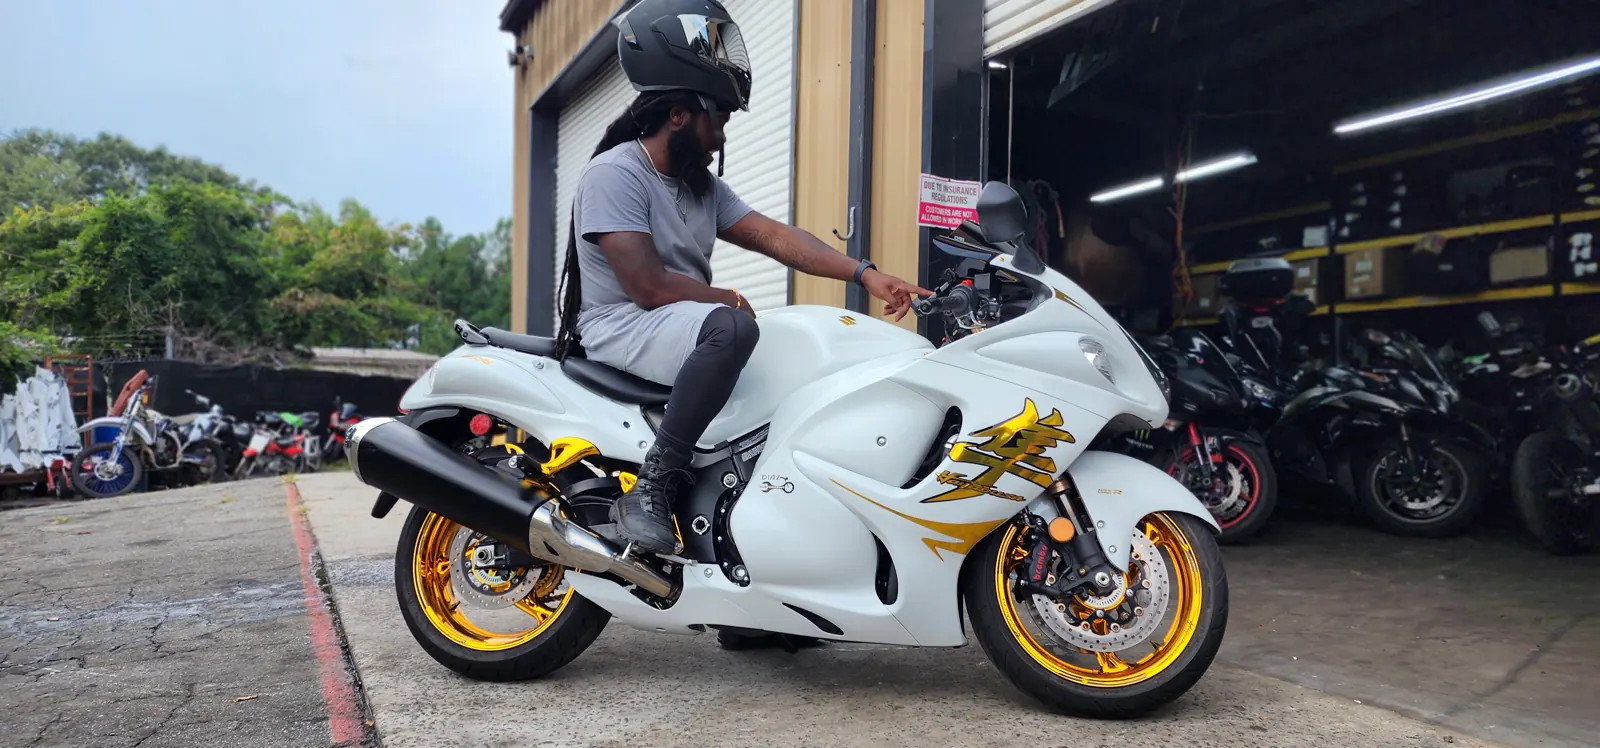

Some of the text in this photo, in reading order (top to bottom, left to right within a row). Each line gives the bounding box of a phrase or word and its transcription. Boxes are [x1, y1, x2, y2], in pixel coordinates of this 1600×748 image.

[924, 181, 977, 196] DUE TO INSURANCE
[931, 192, 968, 205] REGULATIONS
[925, 206, 951, 217] CUSTOMERS
[921, 214, 942, 223] ALLOWED
[1032, 545, 1048, 581] brembo
